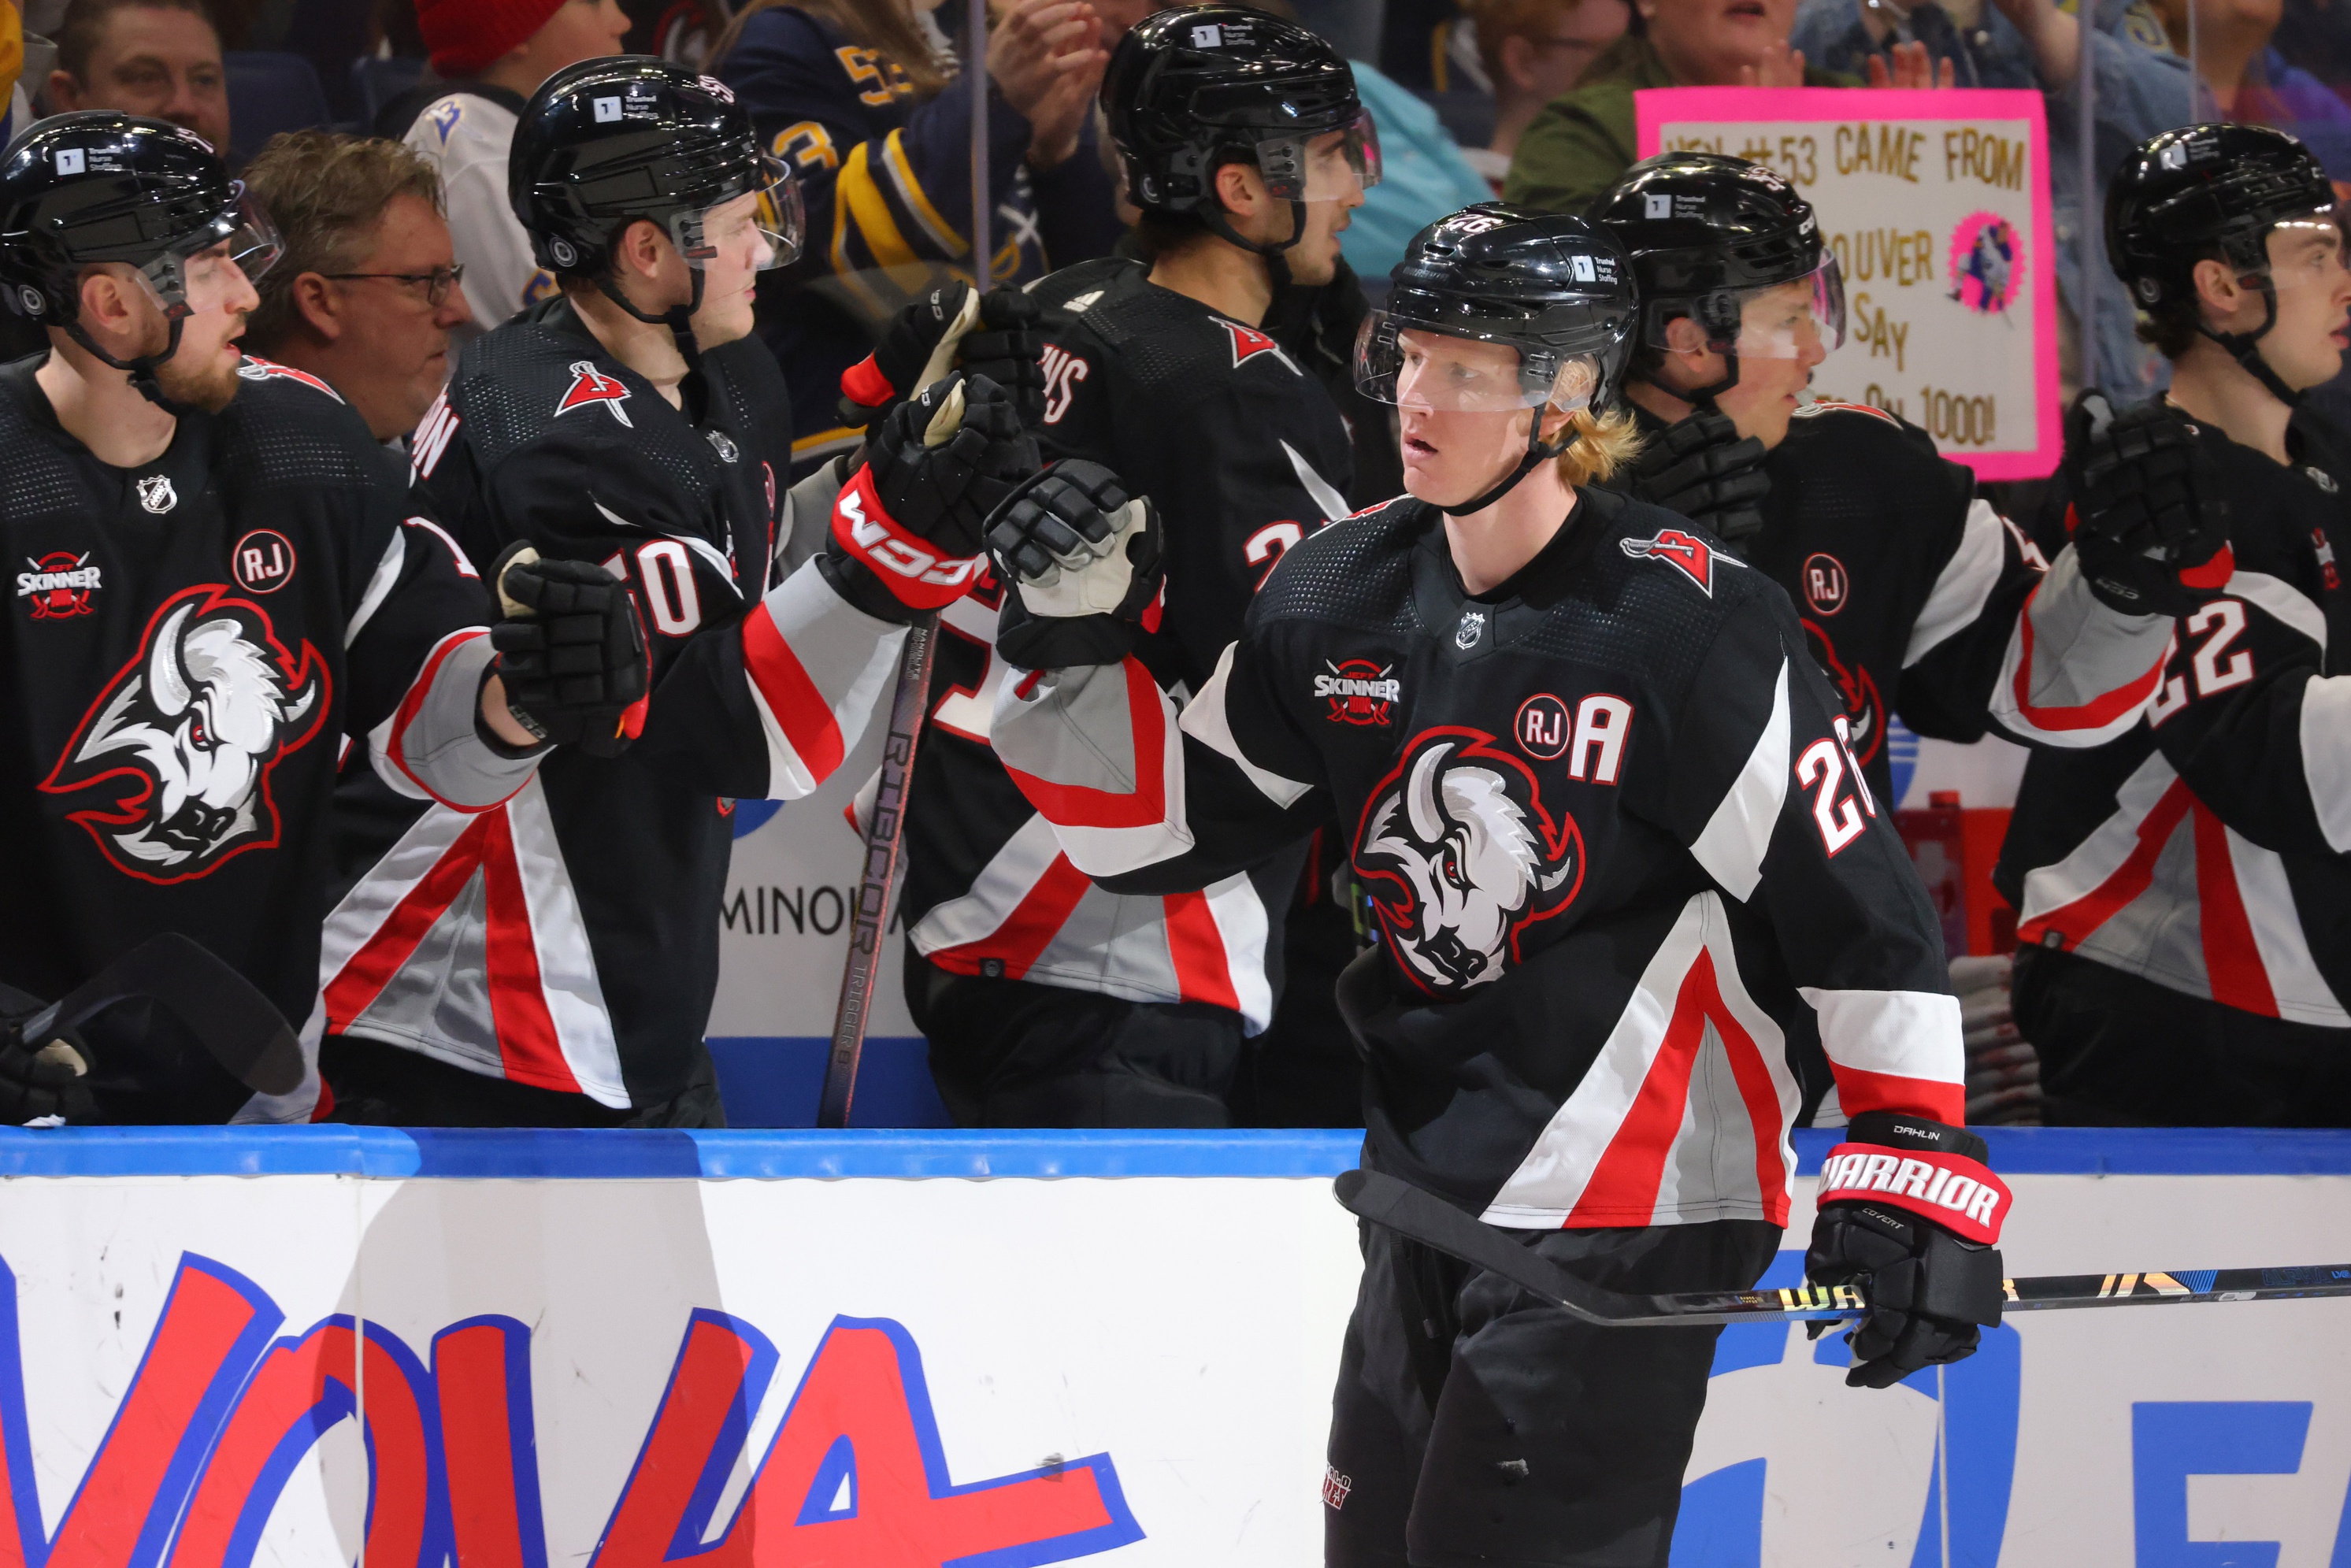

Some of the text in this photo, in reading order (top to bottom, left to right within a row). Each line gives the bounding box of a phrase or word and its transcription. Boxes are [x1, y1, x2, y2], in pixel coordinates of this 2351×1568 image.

[1835, 123, 1925, 183] CAME
[1945, 128, 2025, 191] FROM
[1594, 257, 1615, 267] Trusted
[1596, 265, 1612, 274] Nurse
[1818, 226, 1934, 287] OUVER
[1598, 274, 1618, 285] Staffing
[1854, 292, 1909, 373] SAY
[1920, 384, 1997, 447] 1000!
[17, 565, 103, 597] SKINNER
[242, 543, 285, 583] RJ
[1810, 569, 1840, 601] RJ
[1314, 674, 1401, 703] SKINNER
[1343, 671, 1377, 680] JEFF
[1525, 692, 1636, 787] RJ A
[851, 729, 914, 956] RIBCOR
[722, 886, 906, 936] MINO
[841, 966, 868, 1048] TRIGGER
[1893, 1125, 1941, 1141] DAHLIN
[1862, 1207, 1904, 1230] COVERT
